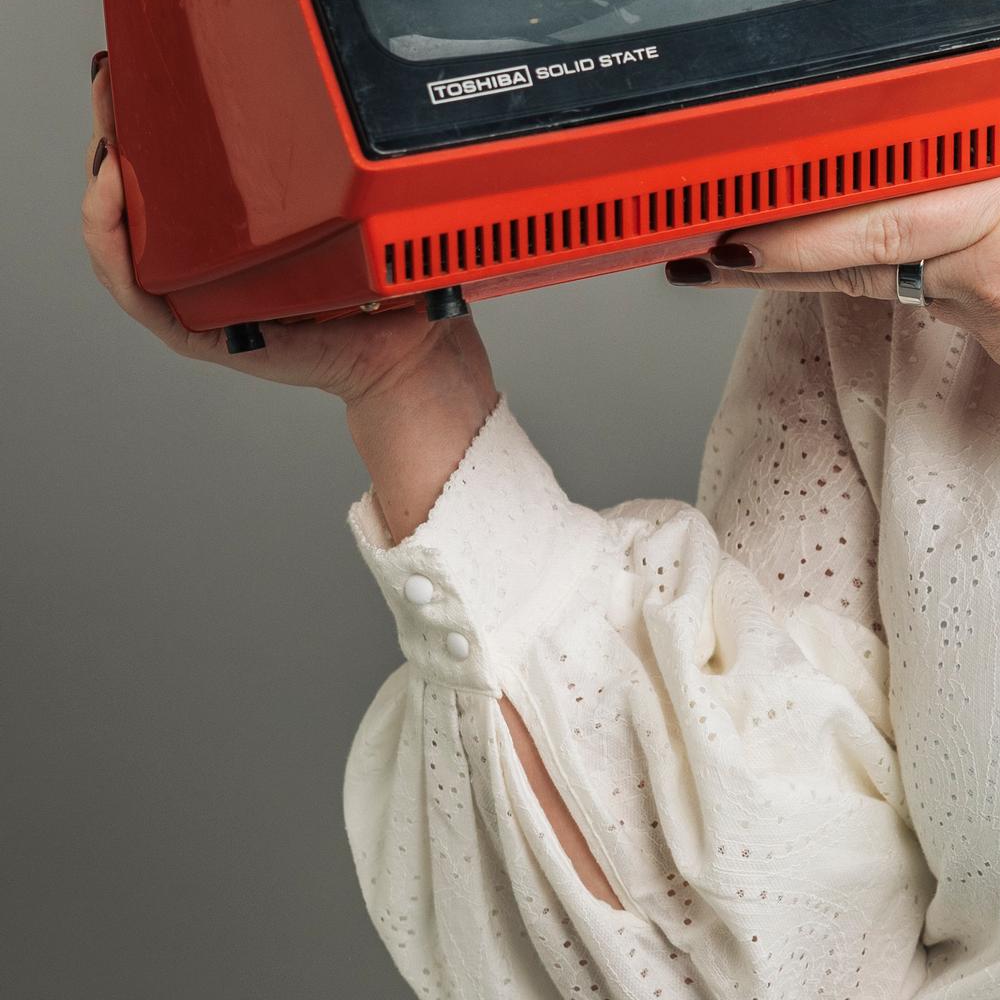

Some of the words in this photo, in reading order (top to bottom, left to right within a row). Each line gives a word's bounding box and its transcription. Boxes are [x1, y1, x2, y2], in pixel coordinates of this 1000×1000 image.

[535, 58, 595, 80] SOLID
[599, 46, 660, 68] STATE
[433, 71, 527, 98] TOSHIBA
